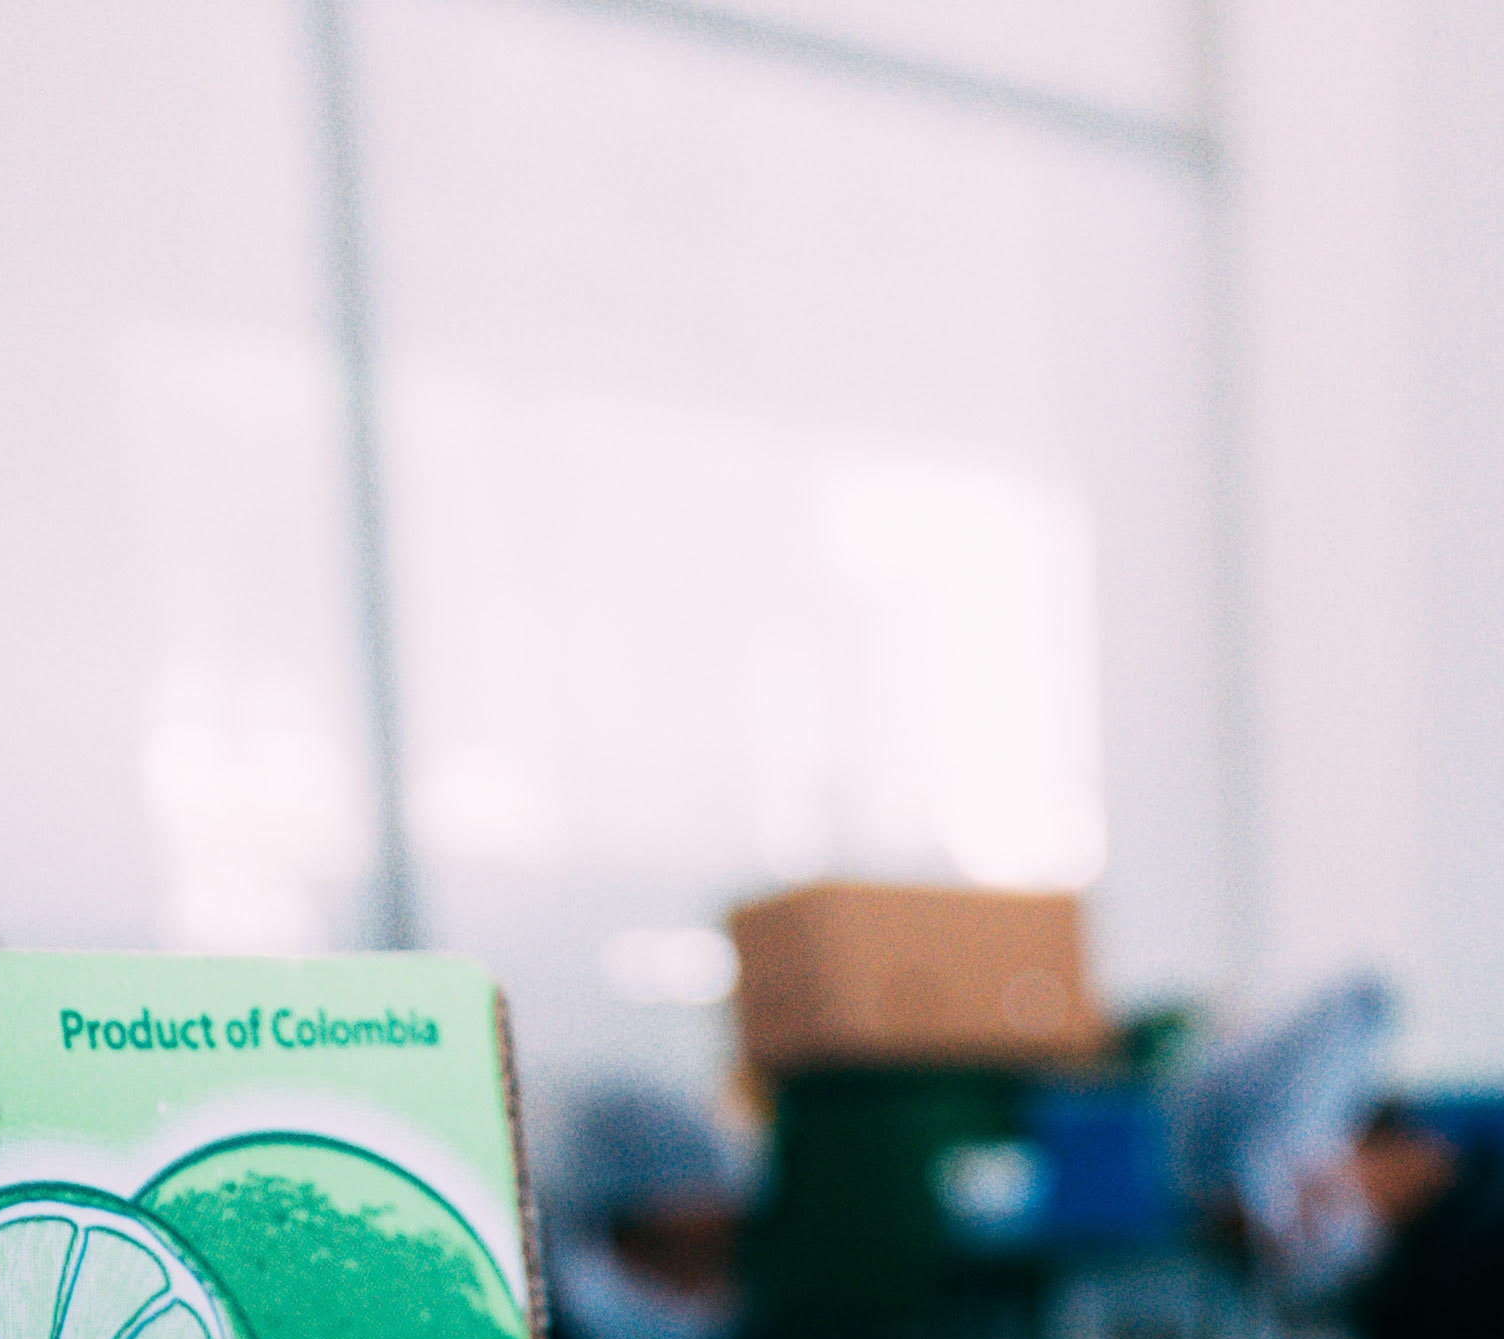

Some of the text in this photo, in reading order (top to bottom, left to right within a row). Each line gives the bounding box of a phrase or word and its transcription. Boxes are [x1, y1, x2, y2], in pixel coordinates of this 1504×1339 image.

[60, 1006, 440, 1051] Product of Colombia
